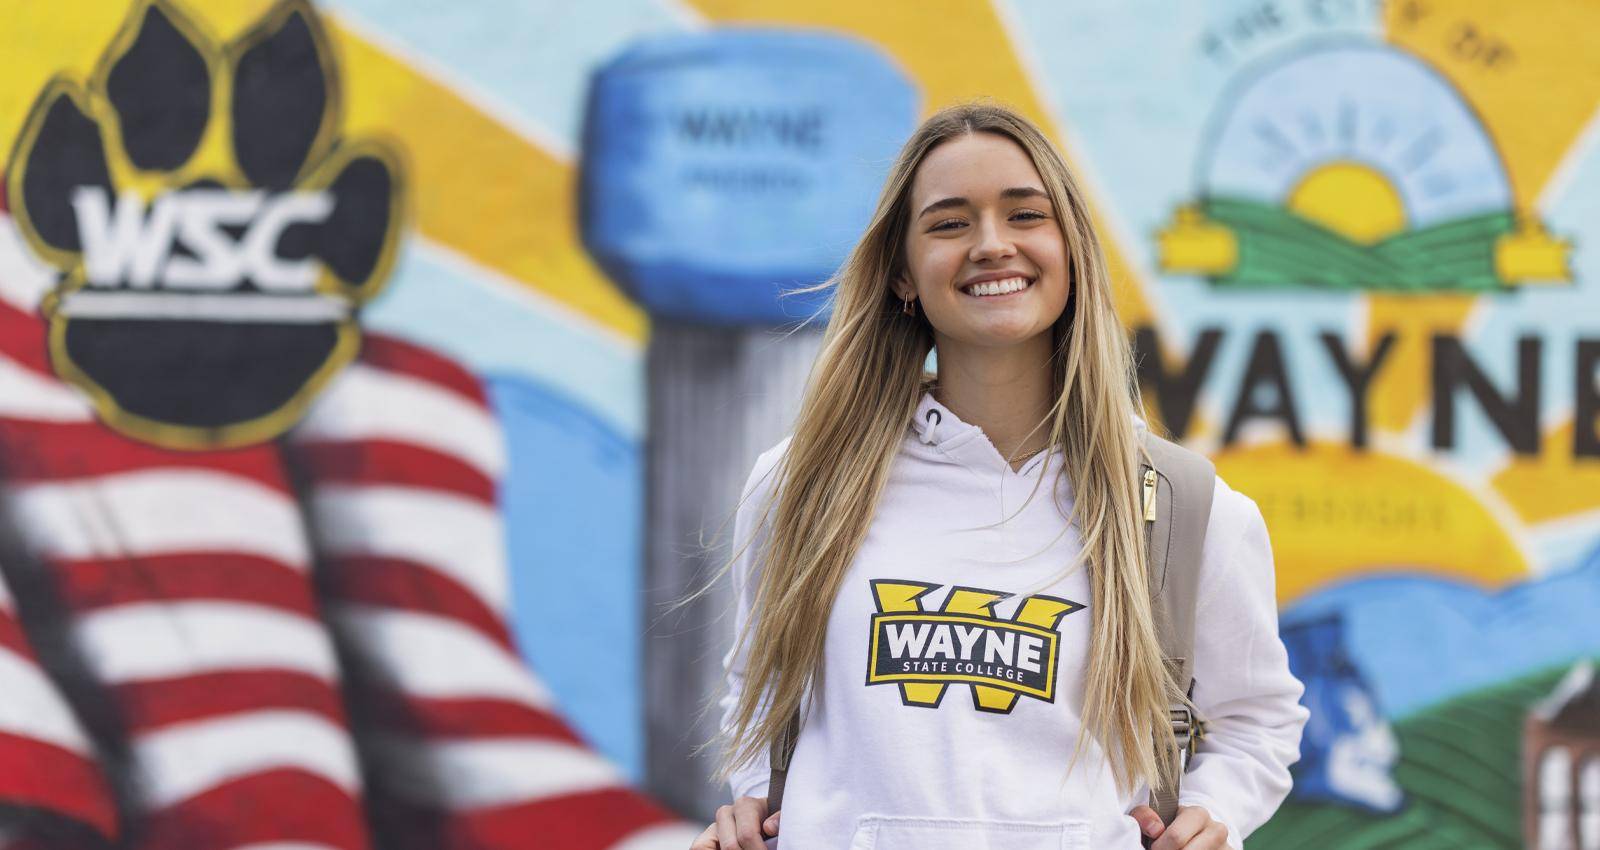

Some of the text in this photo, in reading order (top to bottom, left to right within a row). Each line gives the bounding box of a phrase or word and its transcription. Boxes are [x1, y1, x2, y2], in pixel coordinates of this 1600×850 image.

[72, 184, 336, 288] WSC
[885, 623, 1044, 673] WAYNE
[902, 661, 1024, 682] STATE COLLEGE
